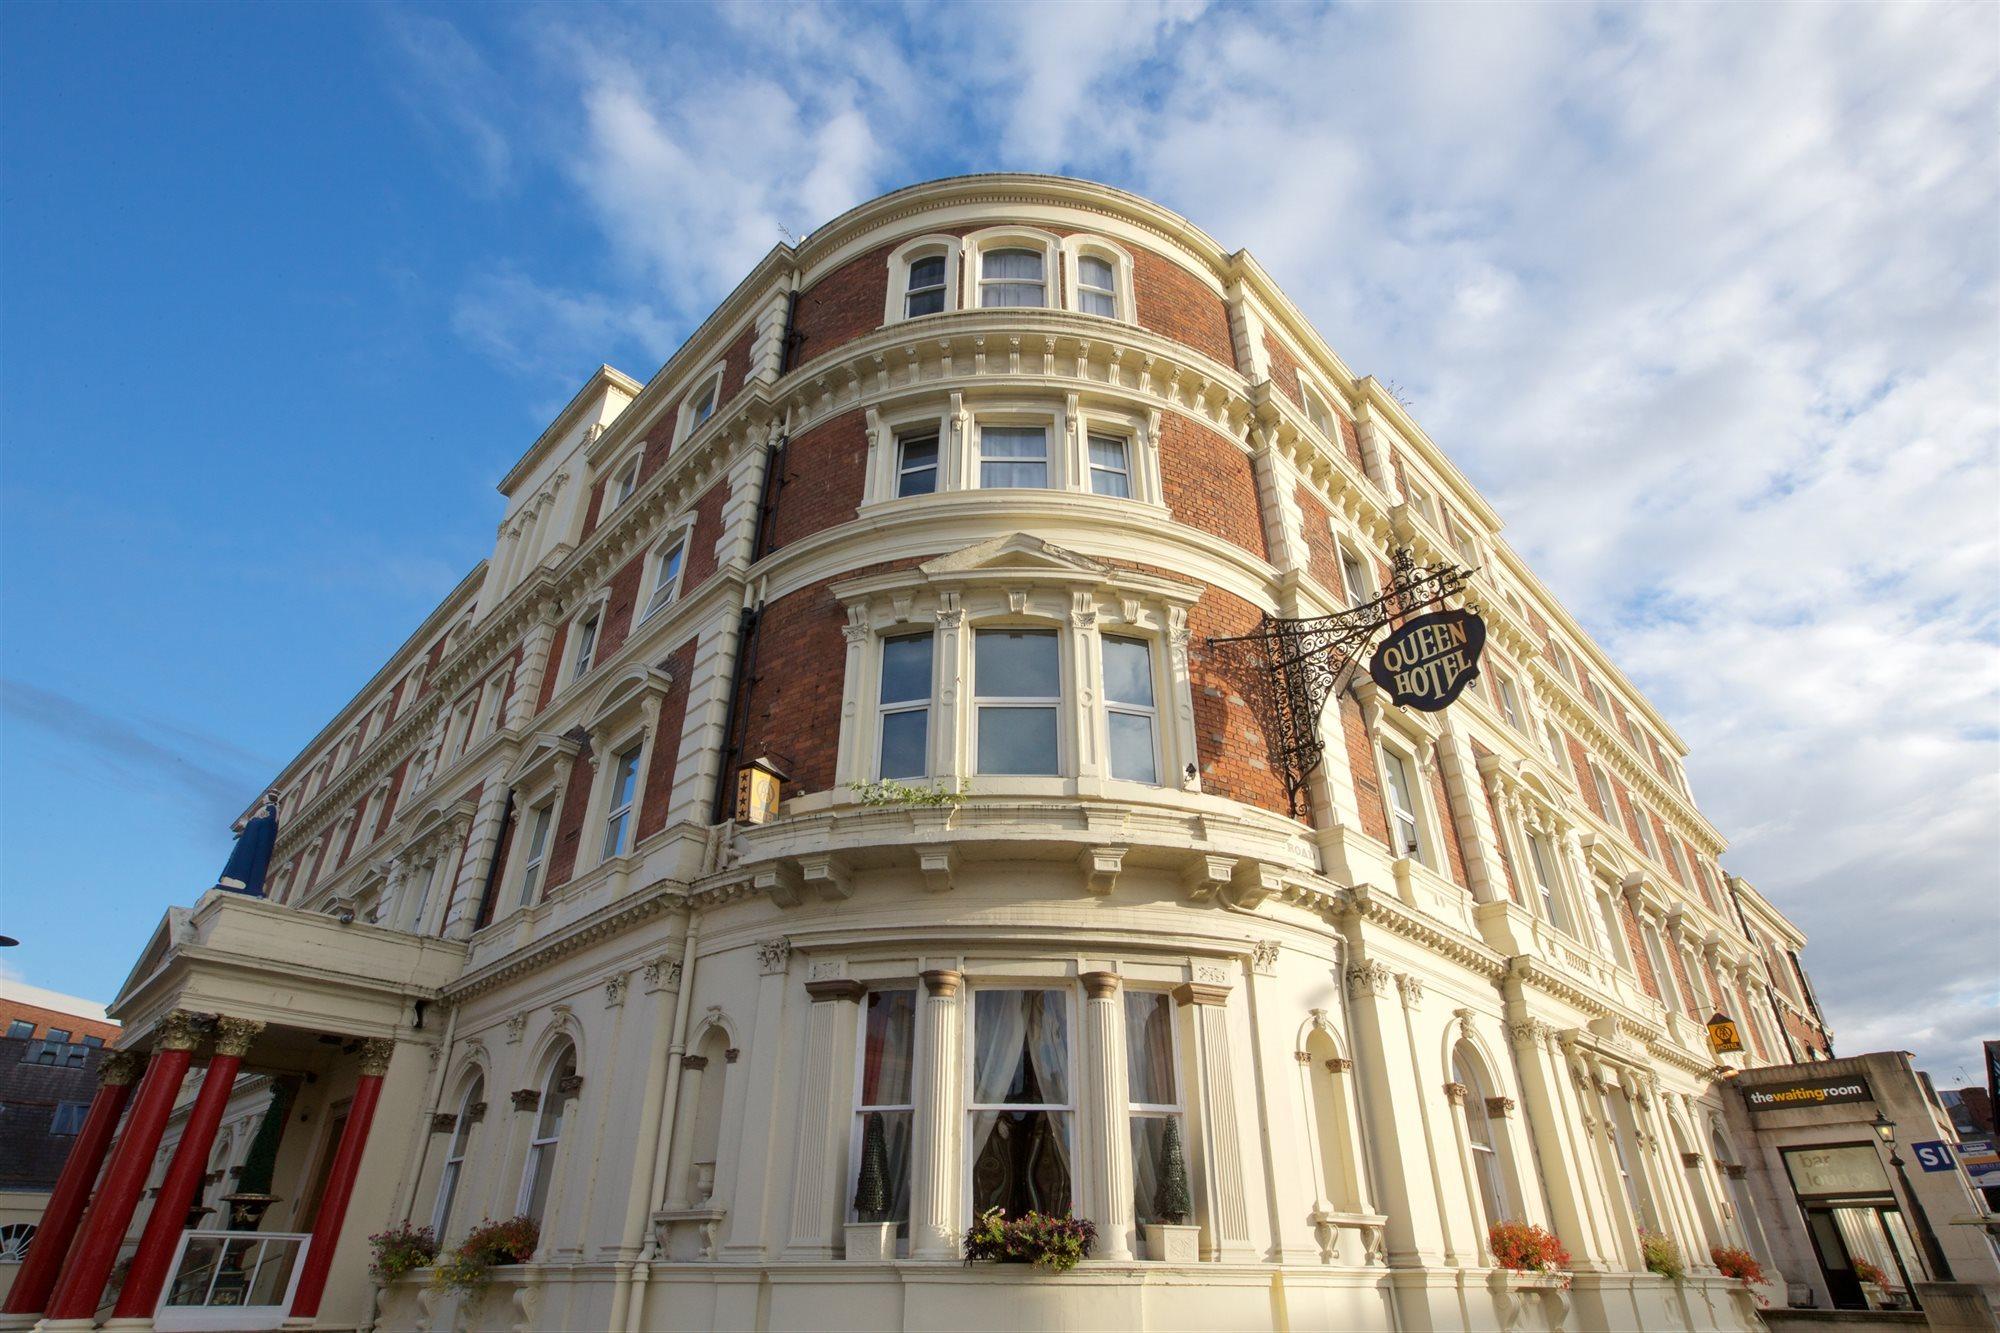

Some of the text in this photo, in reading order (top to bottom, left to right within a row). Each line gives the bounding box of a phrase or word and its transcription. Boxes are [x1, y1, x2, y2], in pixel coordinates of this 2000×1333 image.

[1383, 620, 1468, 672] QUEEN
[1394, 650, 1472, 700] HOTEL
[1751, 1085, 1862, 1103] thewaitingroom
[1799, 1153, 1830, 1169] bar
